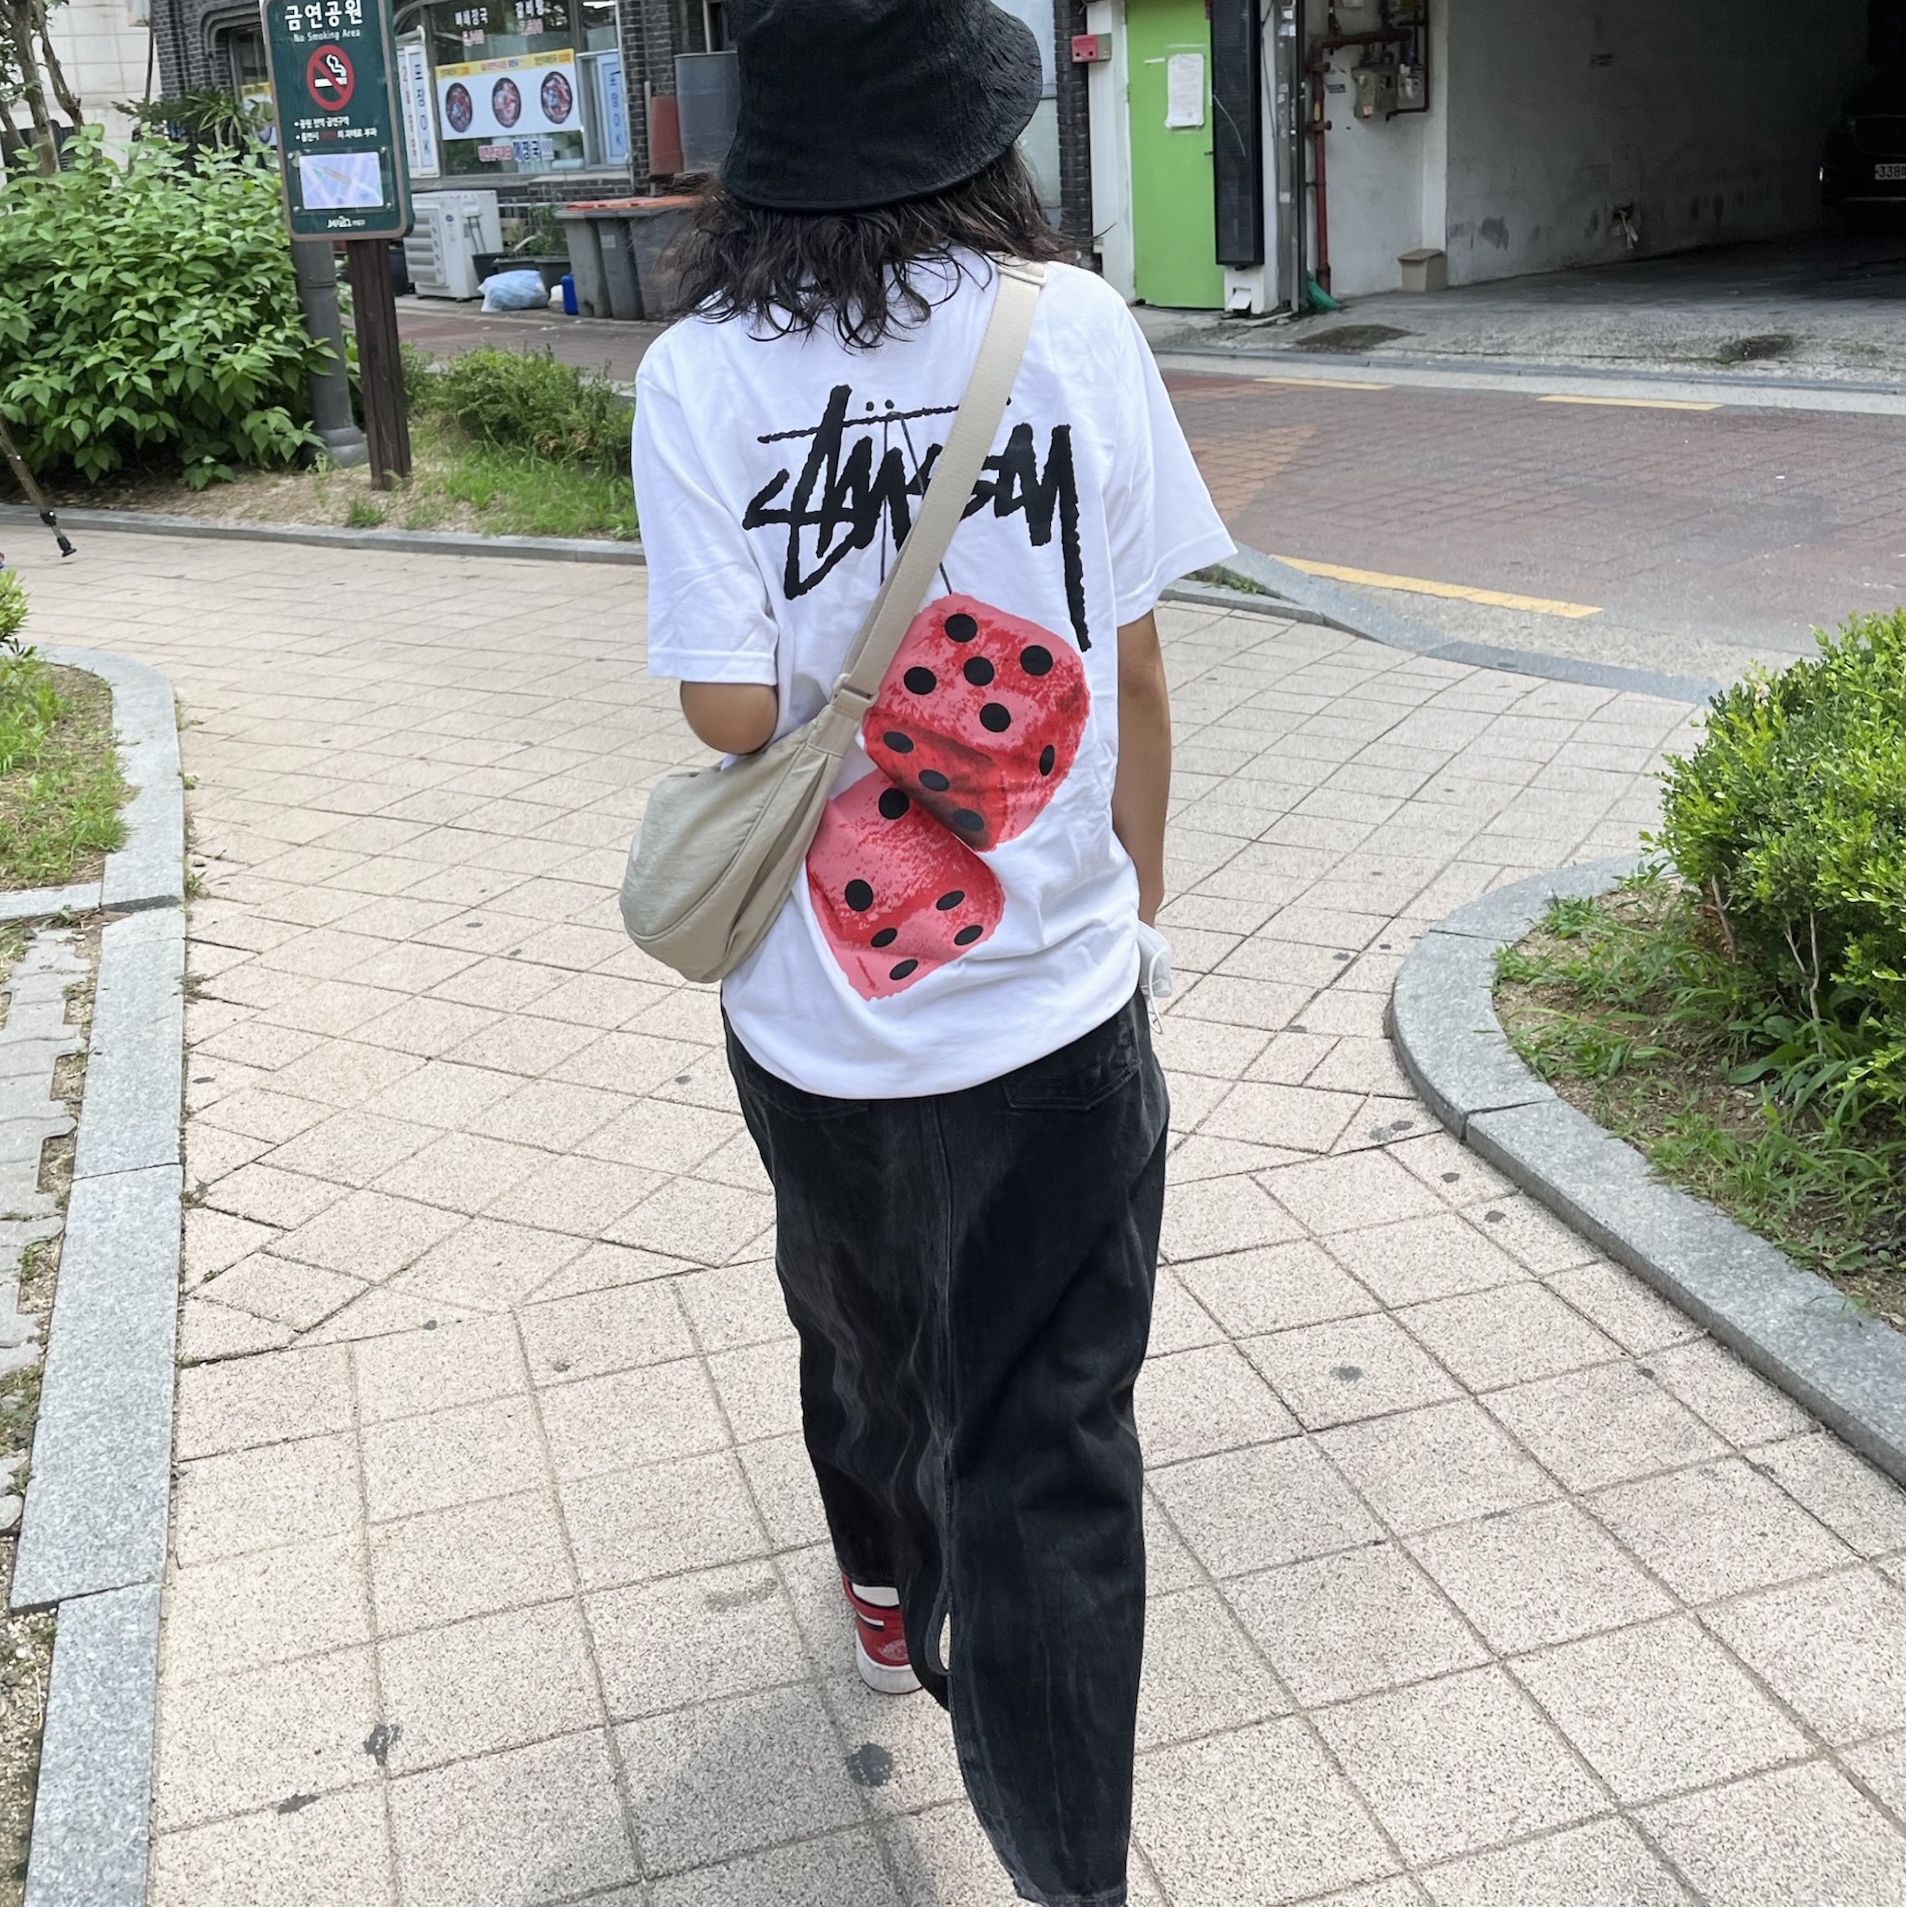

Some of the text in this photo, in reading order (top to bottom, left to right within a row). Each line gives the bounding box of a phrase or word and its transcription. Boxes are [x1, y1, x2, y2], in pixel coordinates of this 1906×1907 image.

[284, 0, 363, 31] 금연공원
[293, 29, 361, 42] No Smoking Area
